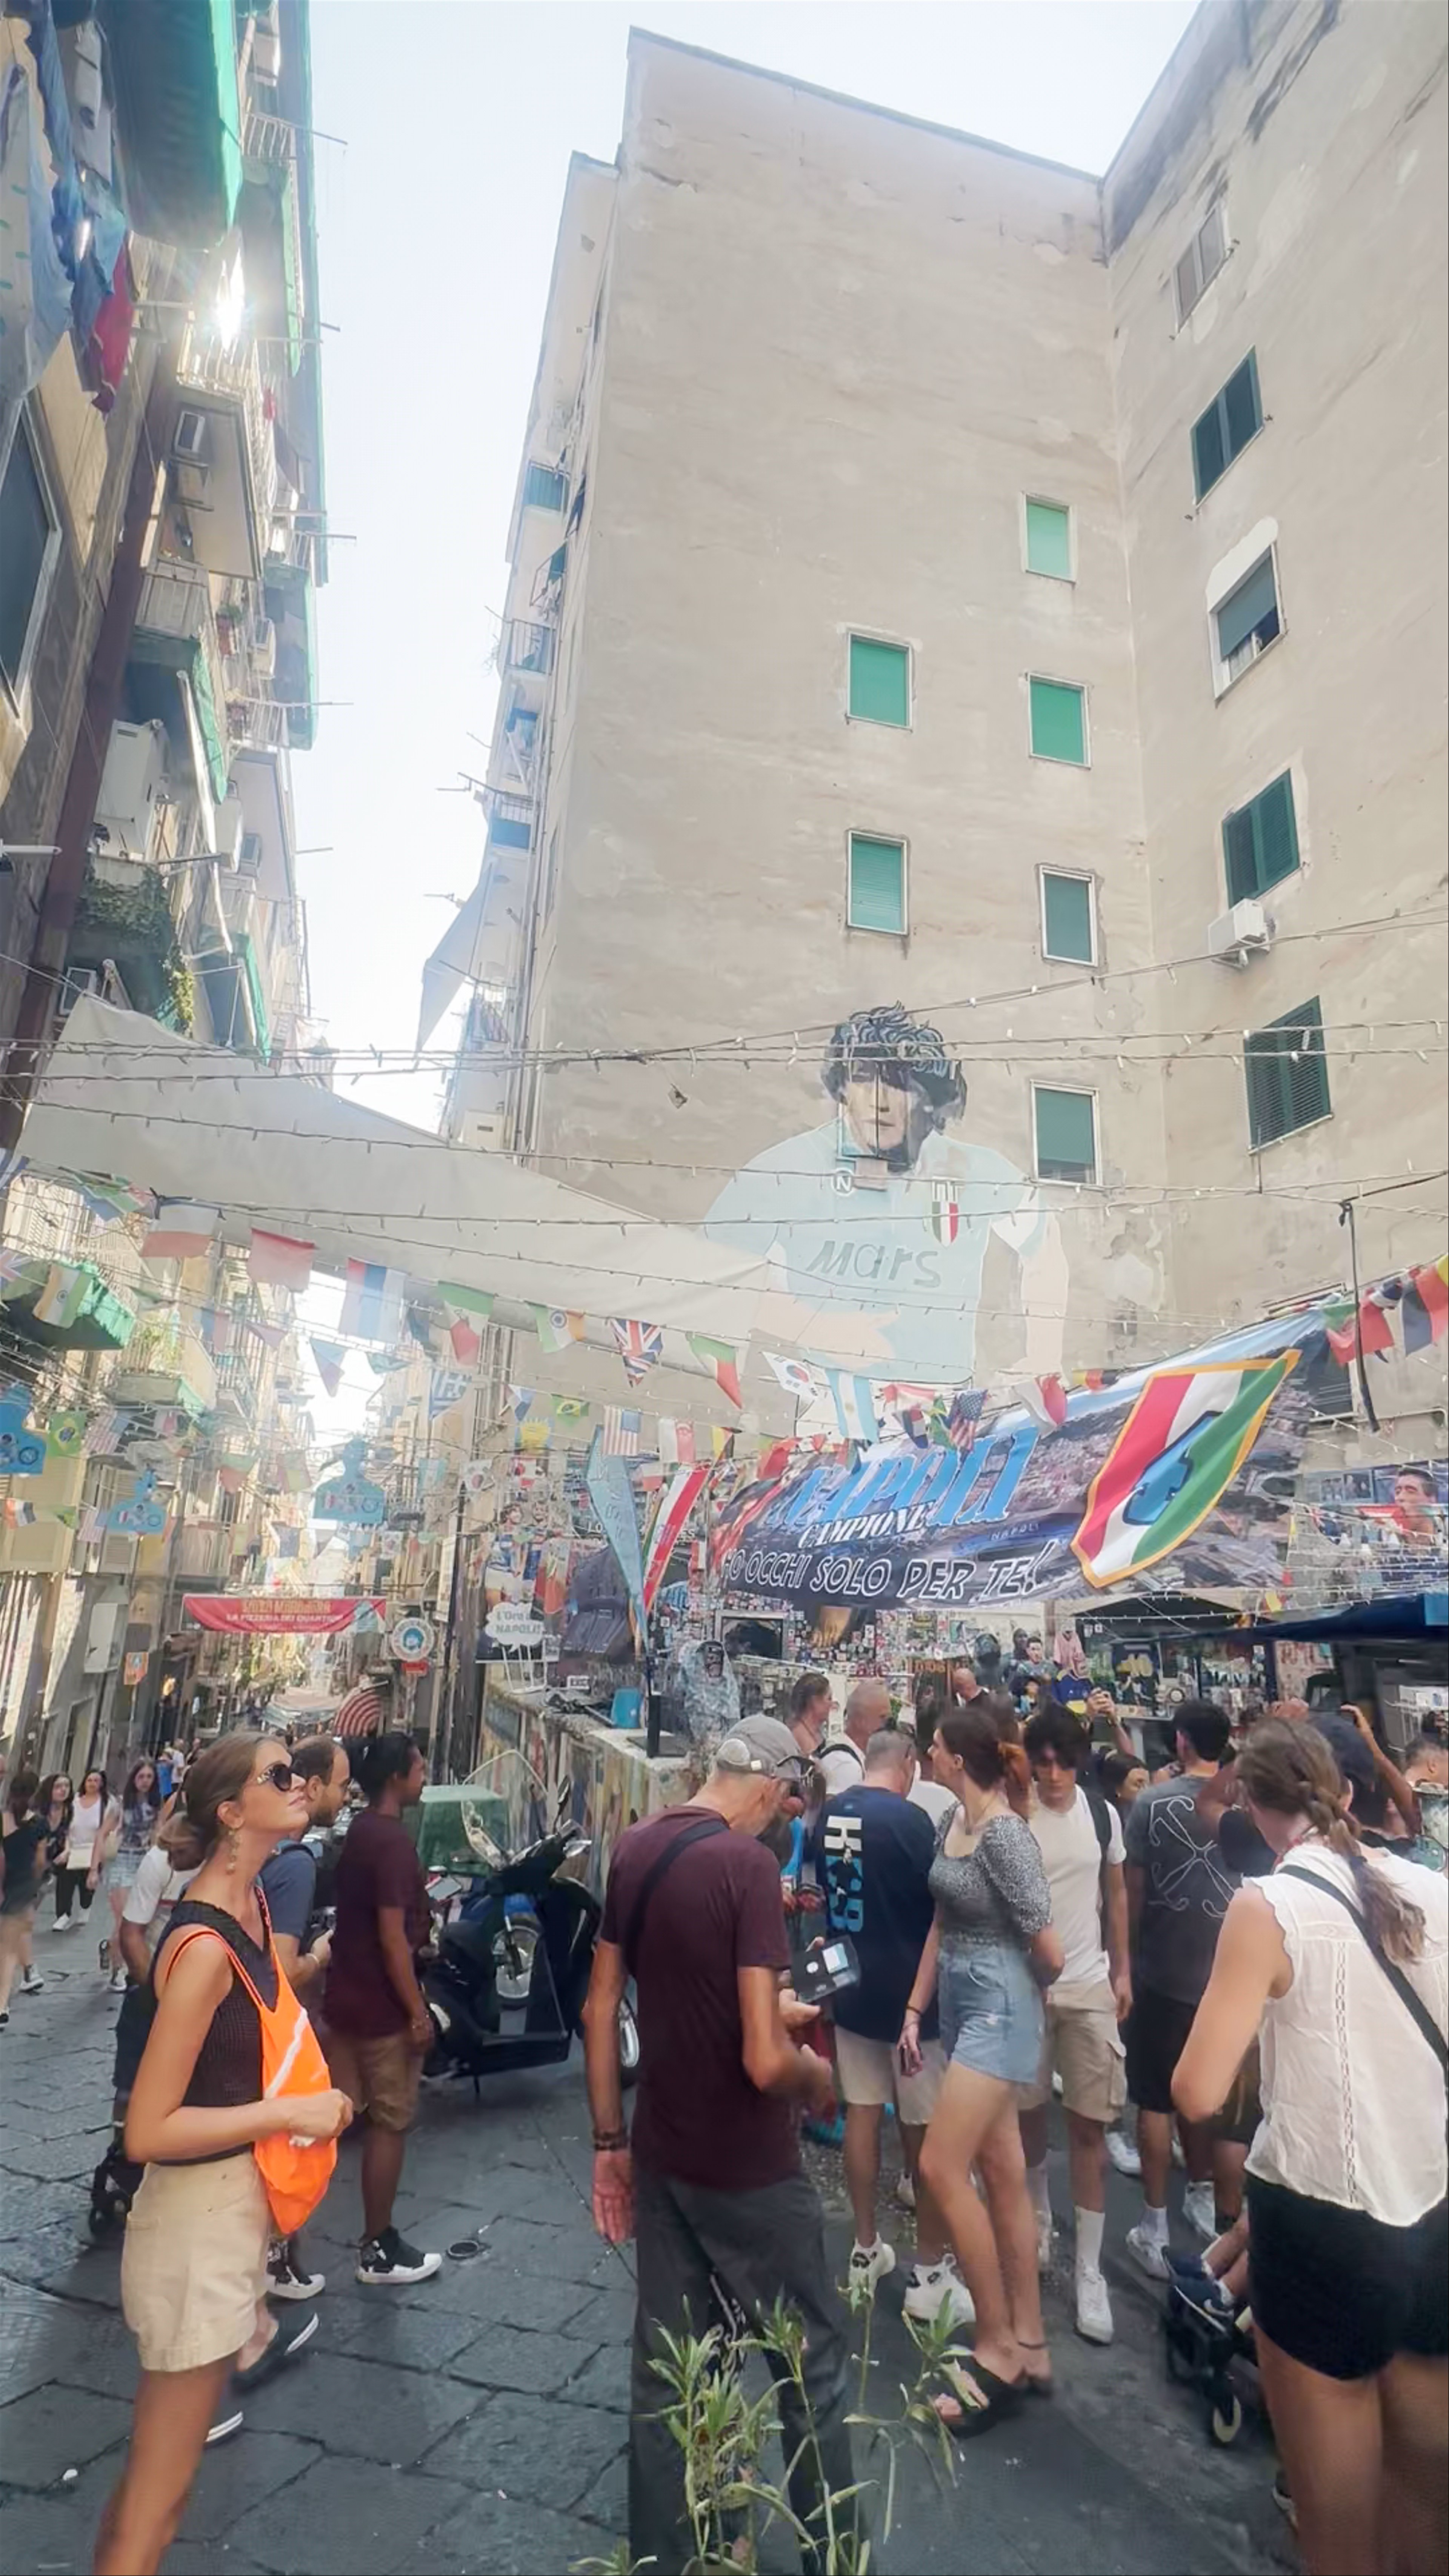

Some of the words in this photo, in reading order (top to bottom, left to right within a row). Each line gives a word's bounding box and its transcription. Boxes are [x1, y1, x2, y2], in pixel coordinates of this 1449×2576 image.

[799, 1503, 937, 1548] CAMPIONE
[991, 1523, 1040, 1541] NAPOLI
[745, 1551, 812, 1589] OCCHI
[810, 1555, 892, 1597] SOLO
[896, 1558, 977, 1600] PER
[982, 1539, 1060, 1597] TE!
